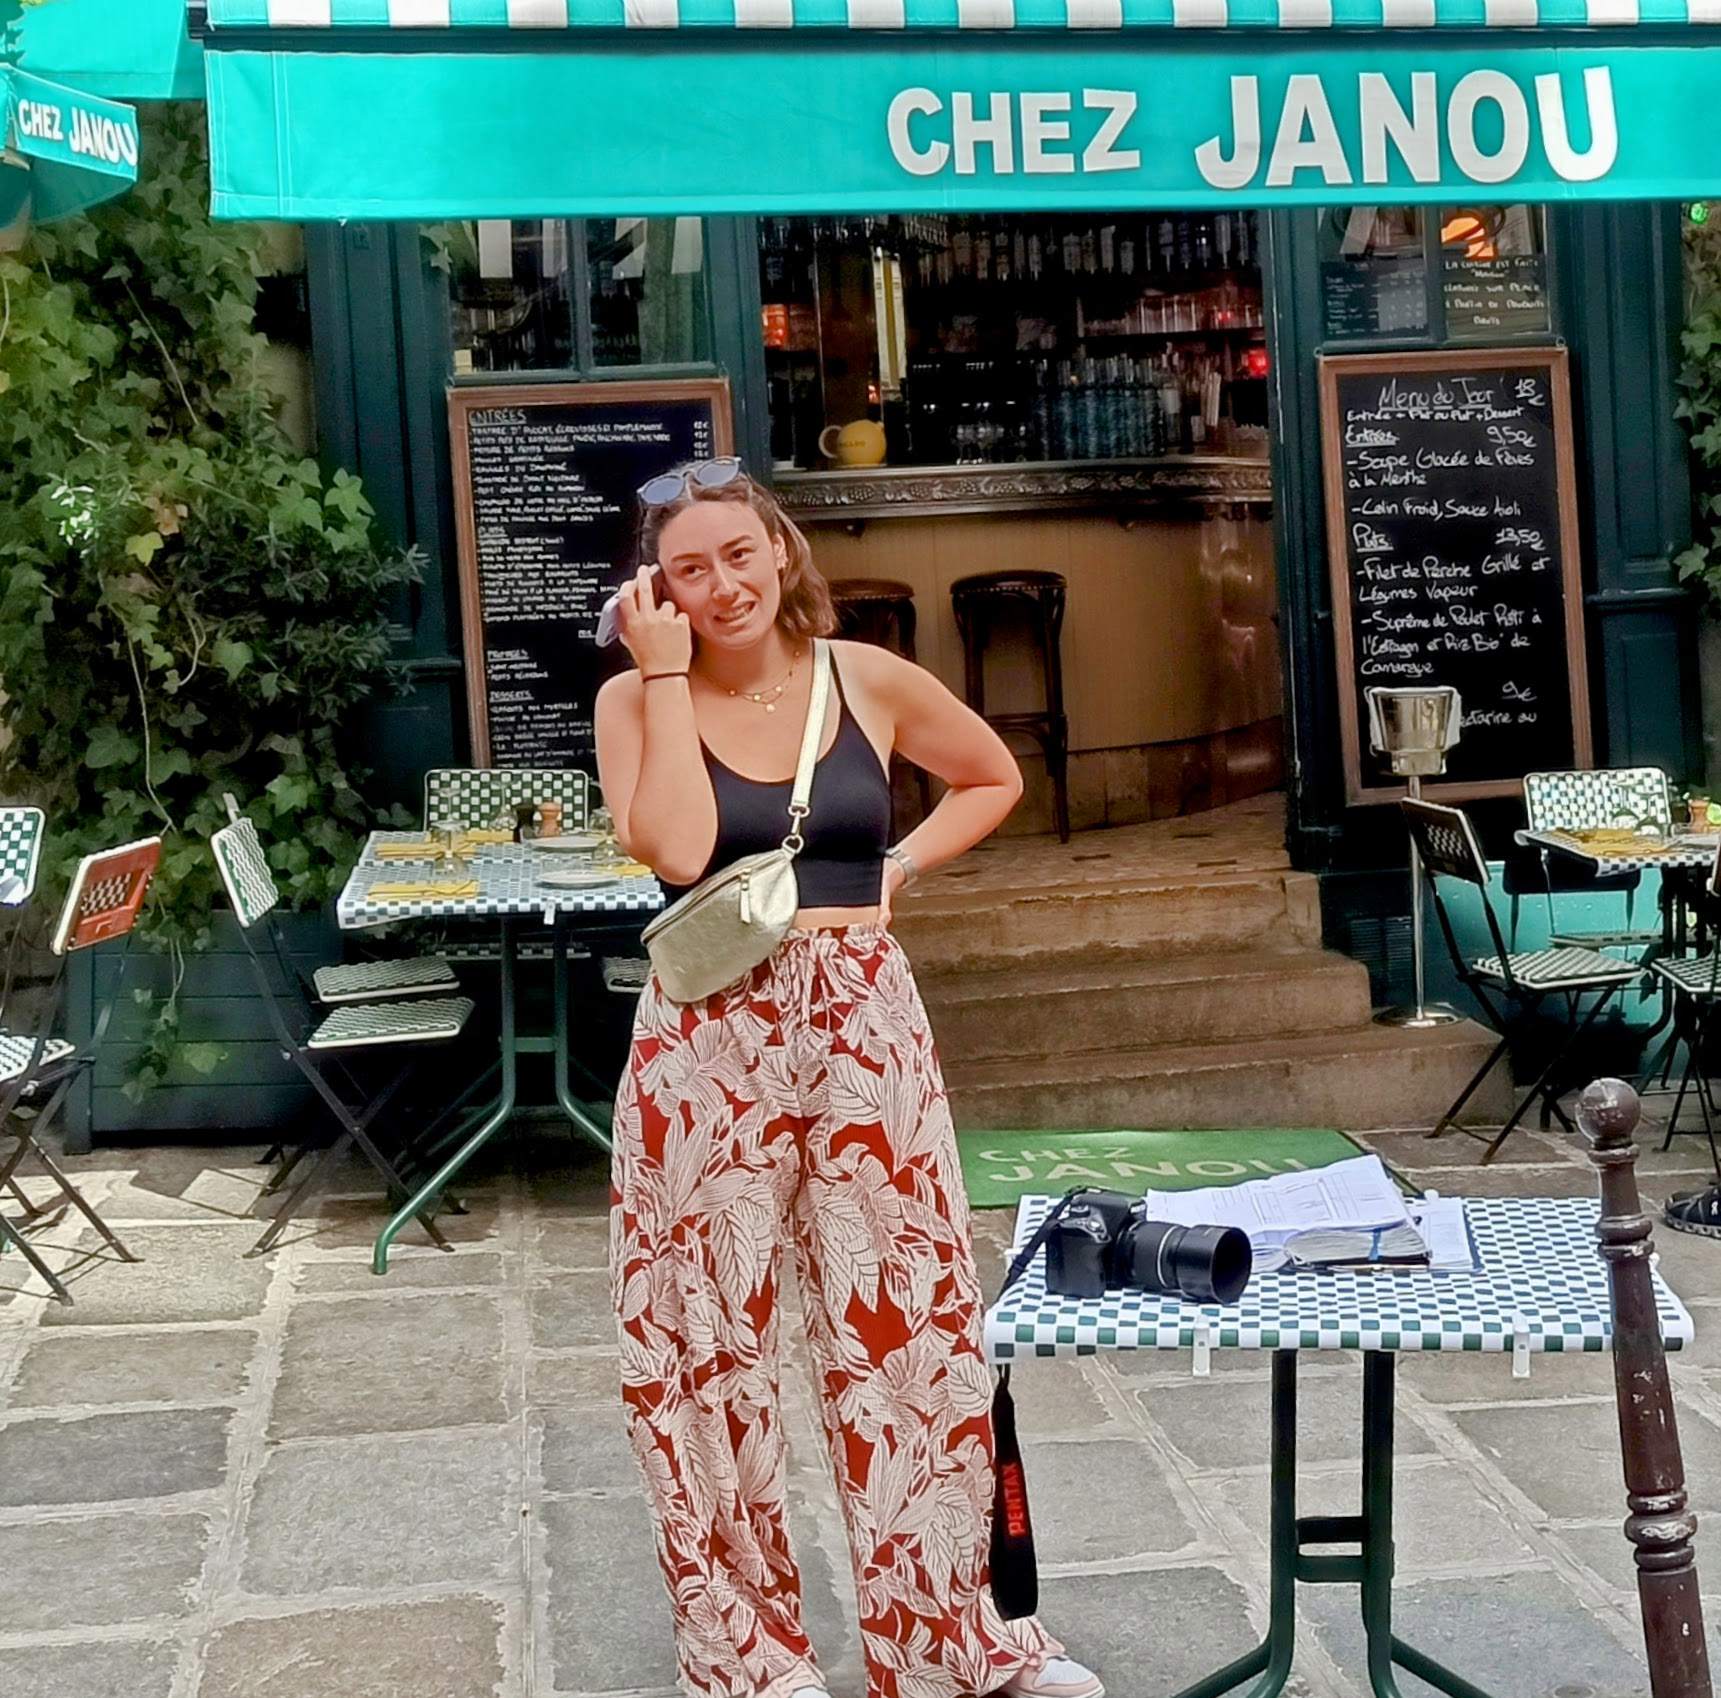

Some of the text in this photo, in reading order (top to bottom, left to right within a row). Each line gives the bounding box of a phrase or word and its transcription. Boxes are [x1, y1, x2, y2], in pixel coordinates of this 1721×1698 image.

[18, 98, 139, 168] CHEZ JANOU
[886, 65, 1620, 190] CHEZ JANOU
[1475, 449, 1494, 466] de
[1348, 471, 1361, 488] à
[1364, 473, 1377, 487] la
[1444, 499, 1489, 519] Sauce
[1402, 561, 1422, 578] de
[1481, 553, 1523, 575] Grillé
[1532, 557, 1551, 572] et
[1358, 580, 1479, 605] Légumes Vapeur
[1433, 613, 1449, 628] de
[1449, 604, 1492, 627] Poulet
[1426, 639, 1443, 651] et
[1510, 632, 1531, 648] de
[1360, 658, 1435, 679] Camargue
[1517, 712, 1537, 724] au
[978, 1146, 1136, 1163] CHEZ
[1002, 1462, 1026, 1537] PENTAX
